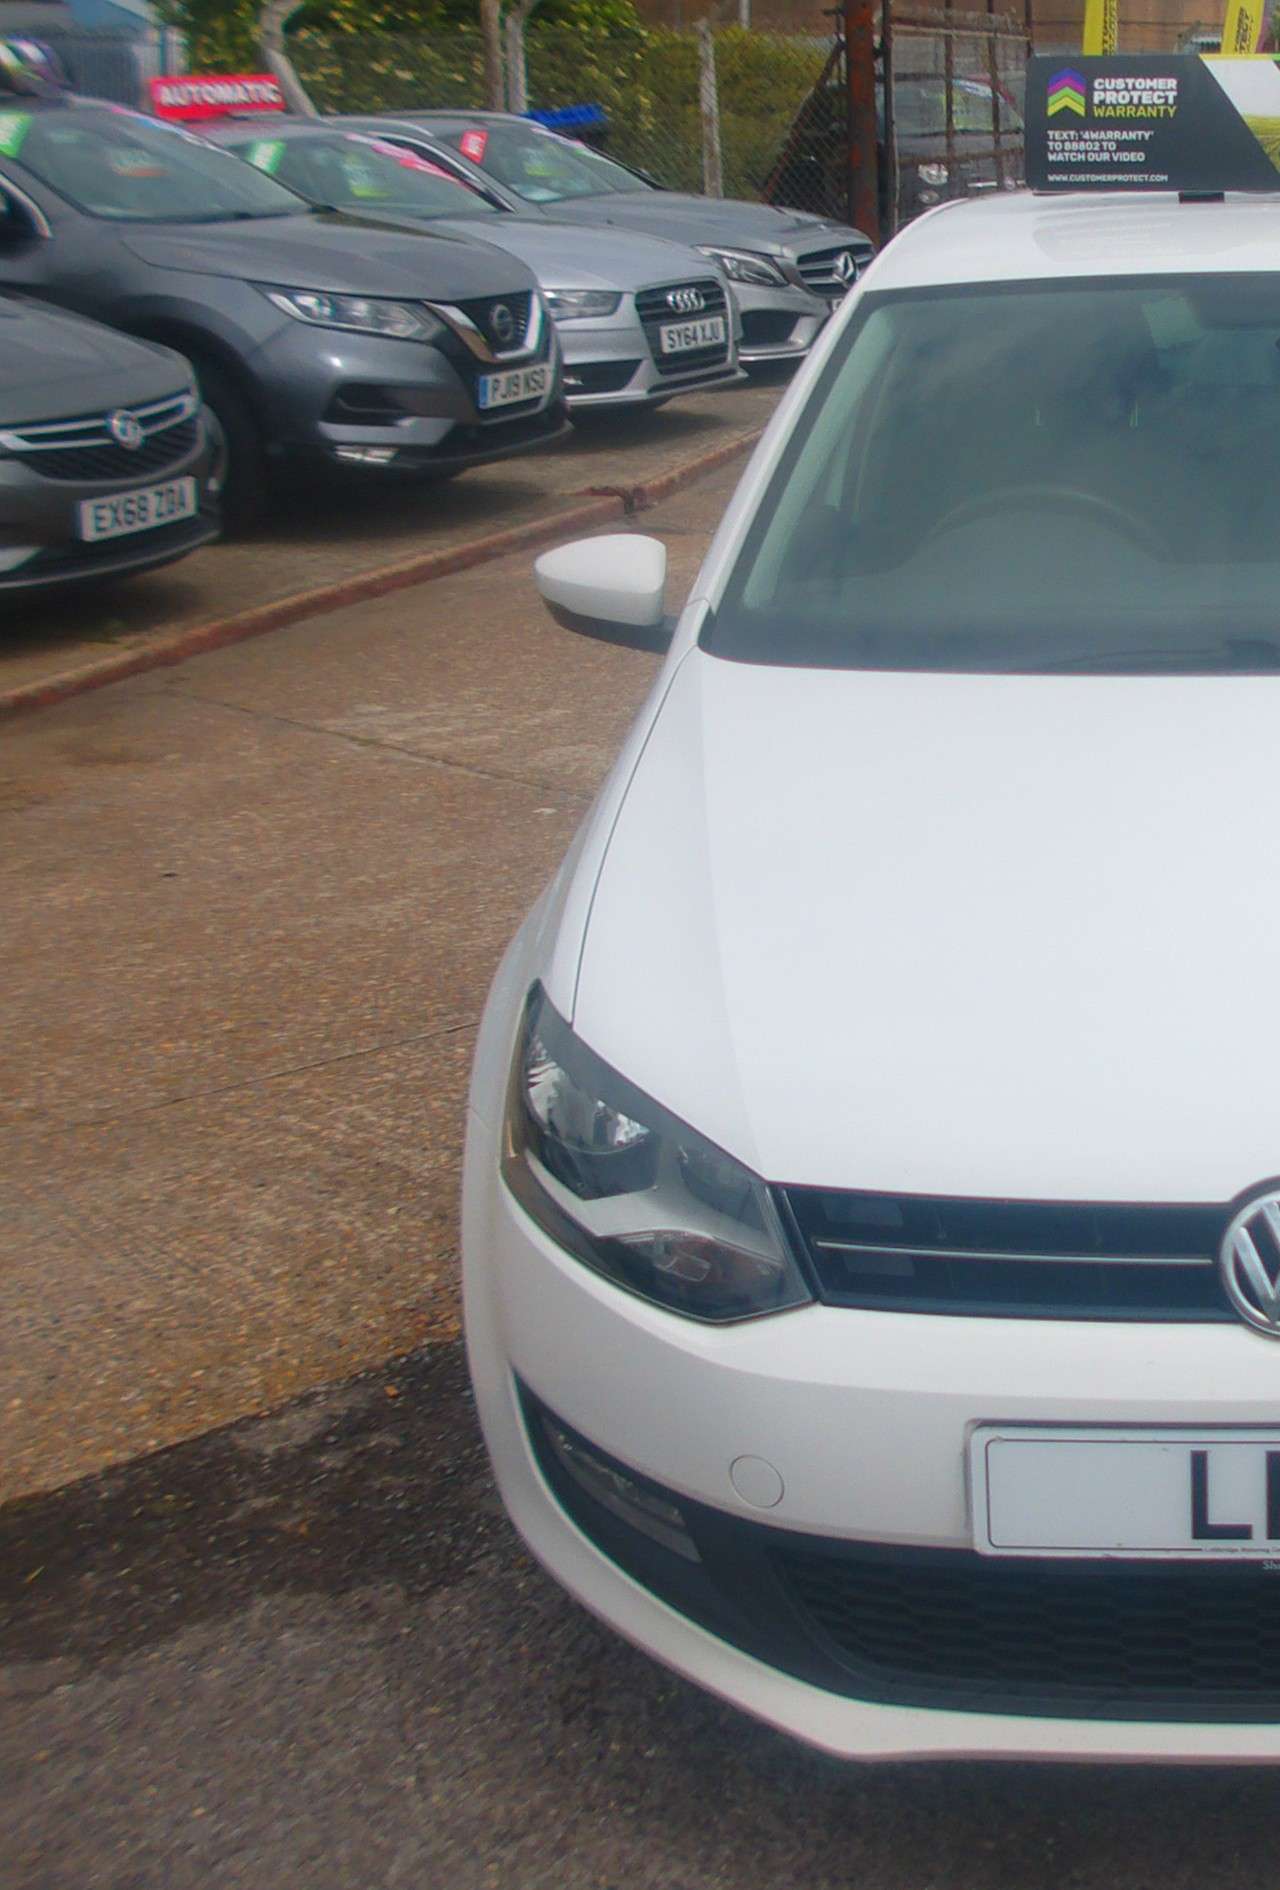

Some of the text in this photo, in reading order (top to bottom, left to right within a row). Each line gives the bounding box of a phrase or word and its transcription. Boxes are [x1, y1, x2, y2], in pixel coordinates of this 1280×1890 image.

[1093, 78, 1178, 90] CUSTOMER
[160, 82, 281, 107] AUTOMATIC
[1093, 91, 1178, 105] PROTECT
[1093, 105, 1178, 118] WARRANTY
[1047, 130, 1079, 141] TEXT:
[1048, 141, 1117, 151] TO 88802 TO
[1047, 152, 1146, 162] WATCH OUR VIDEO
[1048, 174, 1169, 183] WWW.CUSTOMERPROTECT.COM
[667, 325, 698, 349] SY64
